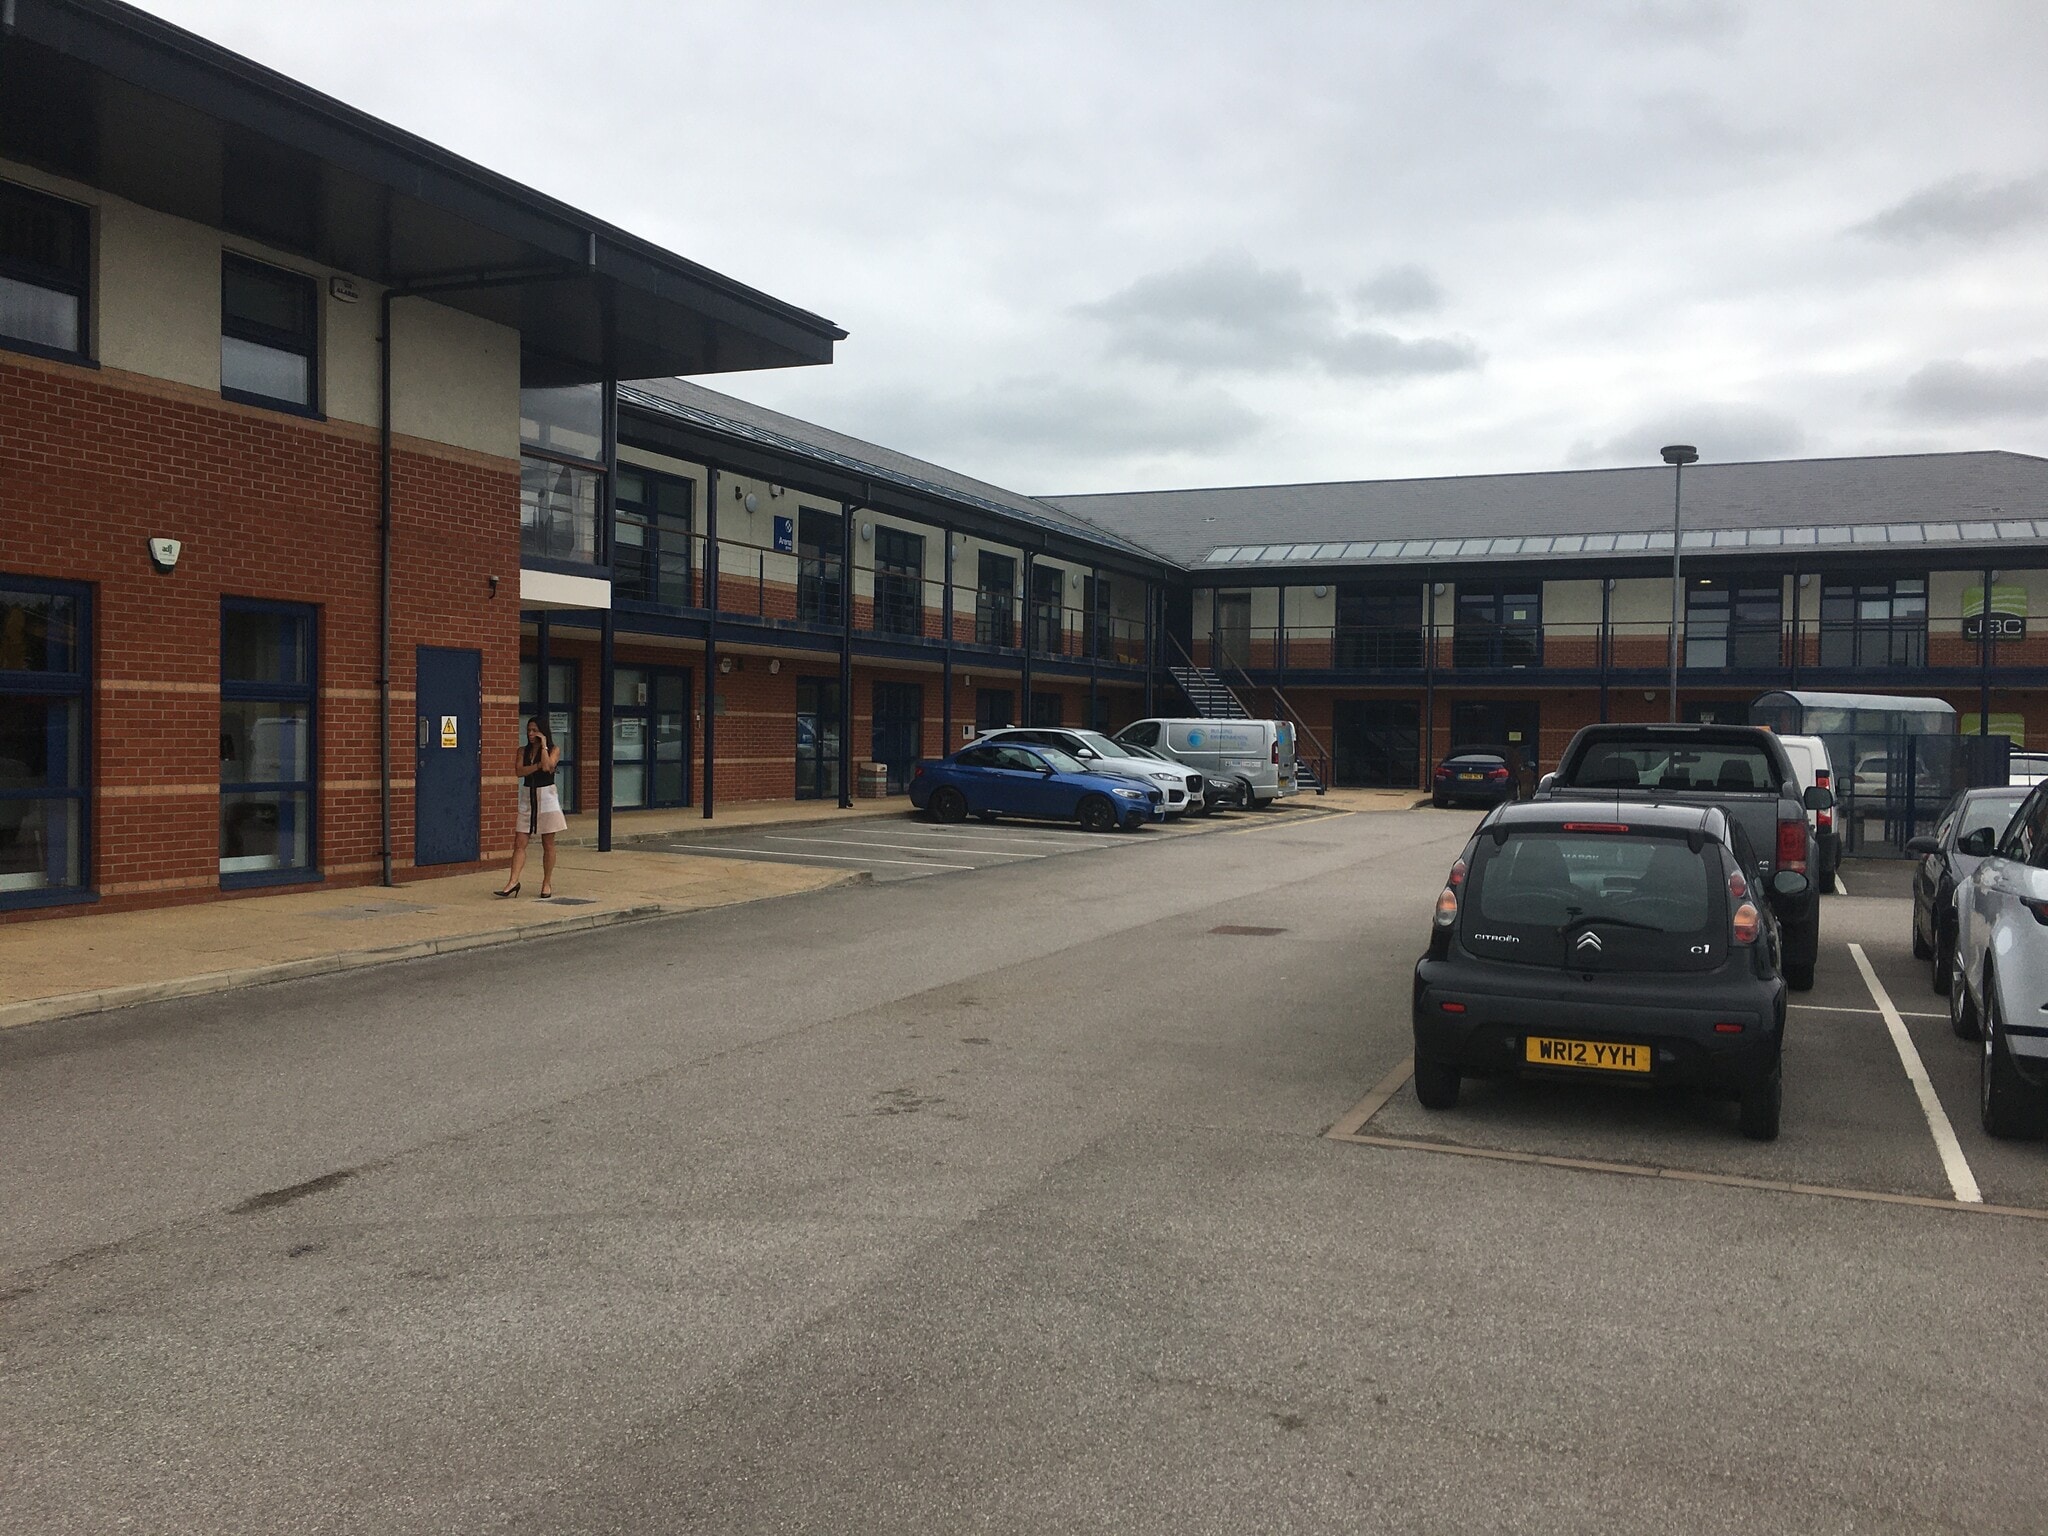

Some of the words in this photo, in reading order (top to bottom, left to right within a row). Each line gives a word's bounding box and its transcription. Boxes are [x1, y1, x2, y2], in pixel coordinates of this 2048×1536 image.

[1967, 619, 2022, 634] JBC
[1690, 944, 1710, 954] C1
[1540, 1040, 1587, 1062] WR12
[1594, 1044, 1636, 1067] YYH
